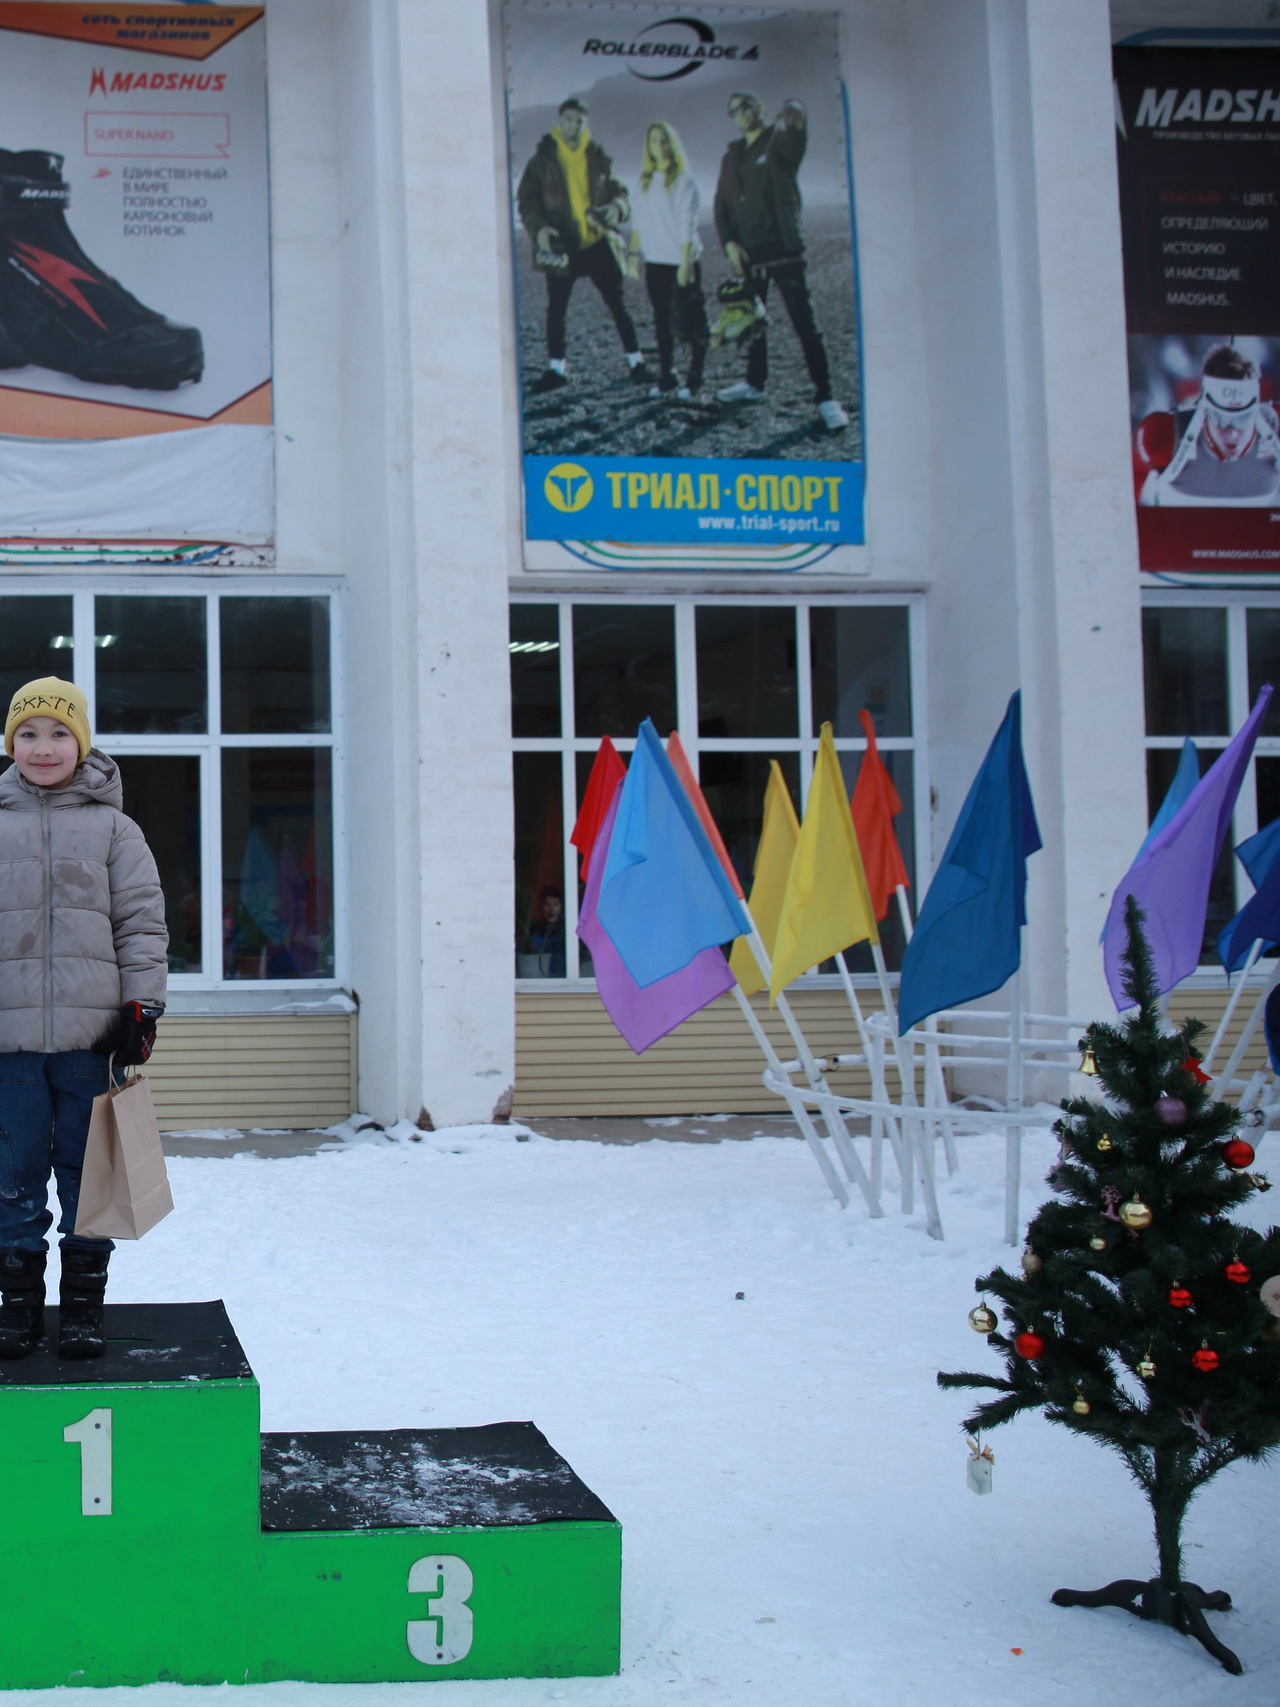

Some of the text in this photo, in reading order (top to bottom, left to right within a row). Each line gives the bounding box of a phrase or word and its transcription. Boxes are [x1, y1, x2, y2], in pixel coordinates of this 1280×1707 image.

[82, 13, 235, 28] сеть спортивных
[116, 29, 210, 41] магазинов
[110, 71, 227, 93] MADSHUS
[94, 129, 174, 142] SUPER NANO
[122, 167, 227, 180] ЕДИНСТВЕННЫЙ
[123, 183, 169, 194] В МИРЕ
[122, 196, 207, 208] ПОЛНОСТЬЮ
[122, 210, 213, 223] КАРБОНОВЫЙ
[1160, 215, 1269, 231] ОПРЕДЕЛЯЮЩИЙ
[122, 225, 186, 236] БОТИНОК
[1163, 242, 1226, 255] ИСТОРИЮ
[1165, 267, 1241, 281] И НАСЛЕДИЕ
[698, 514, 840, 533] www.trial-sport.ru
[63, 1407, 113, 1516] 1
[406, 1554, 474, 1666] 3
